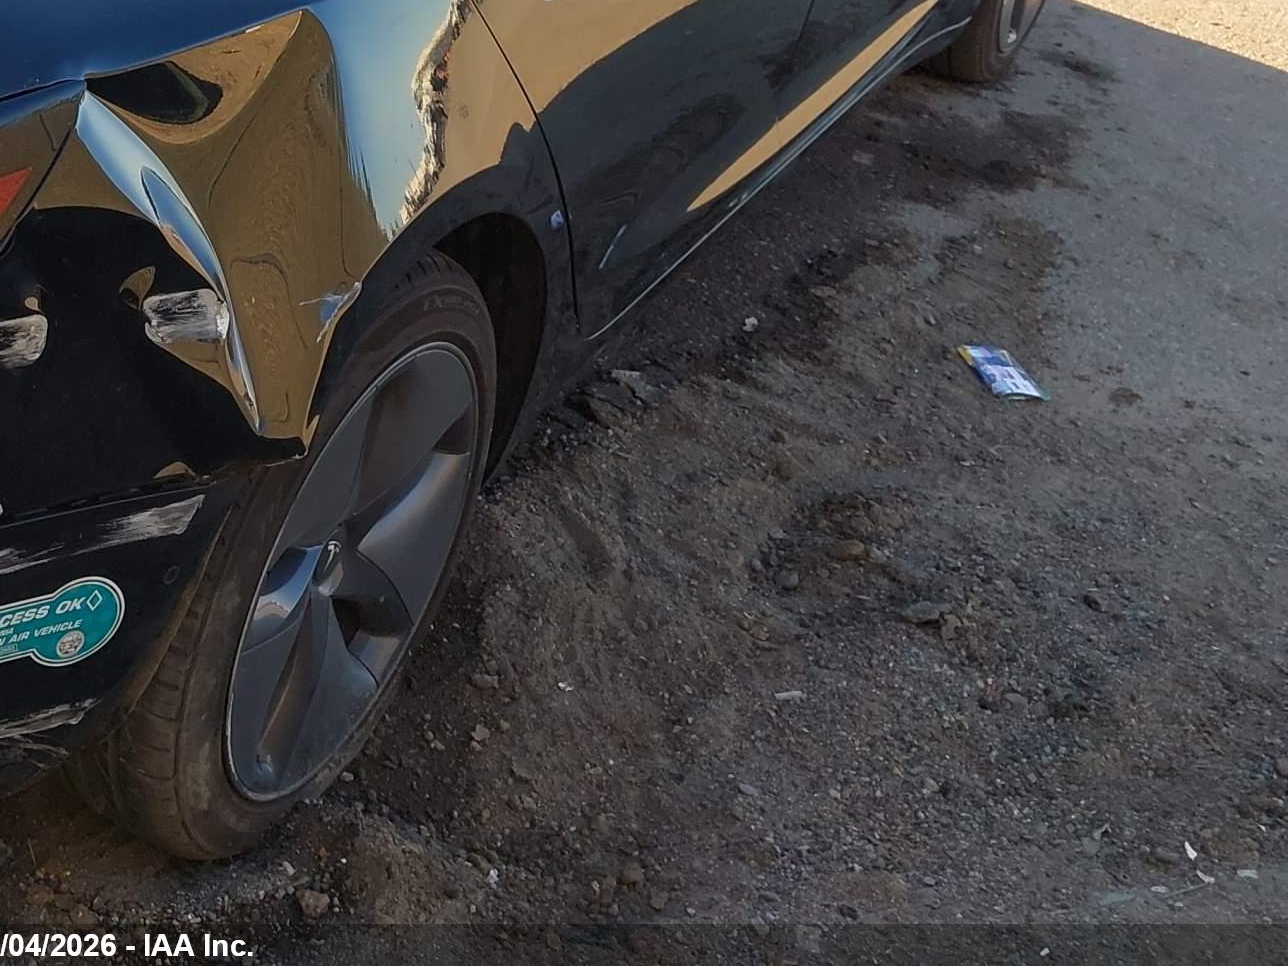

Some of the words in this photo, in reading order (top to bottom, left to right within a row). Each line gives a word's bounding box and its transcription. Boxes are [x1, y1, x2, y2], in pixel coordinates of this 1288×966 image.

[55, 596, 87, 615] OK
[8, 630, 30, 644] AIR
[33, 619, 84, 638] VEHICLE
